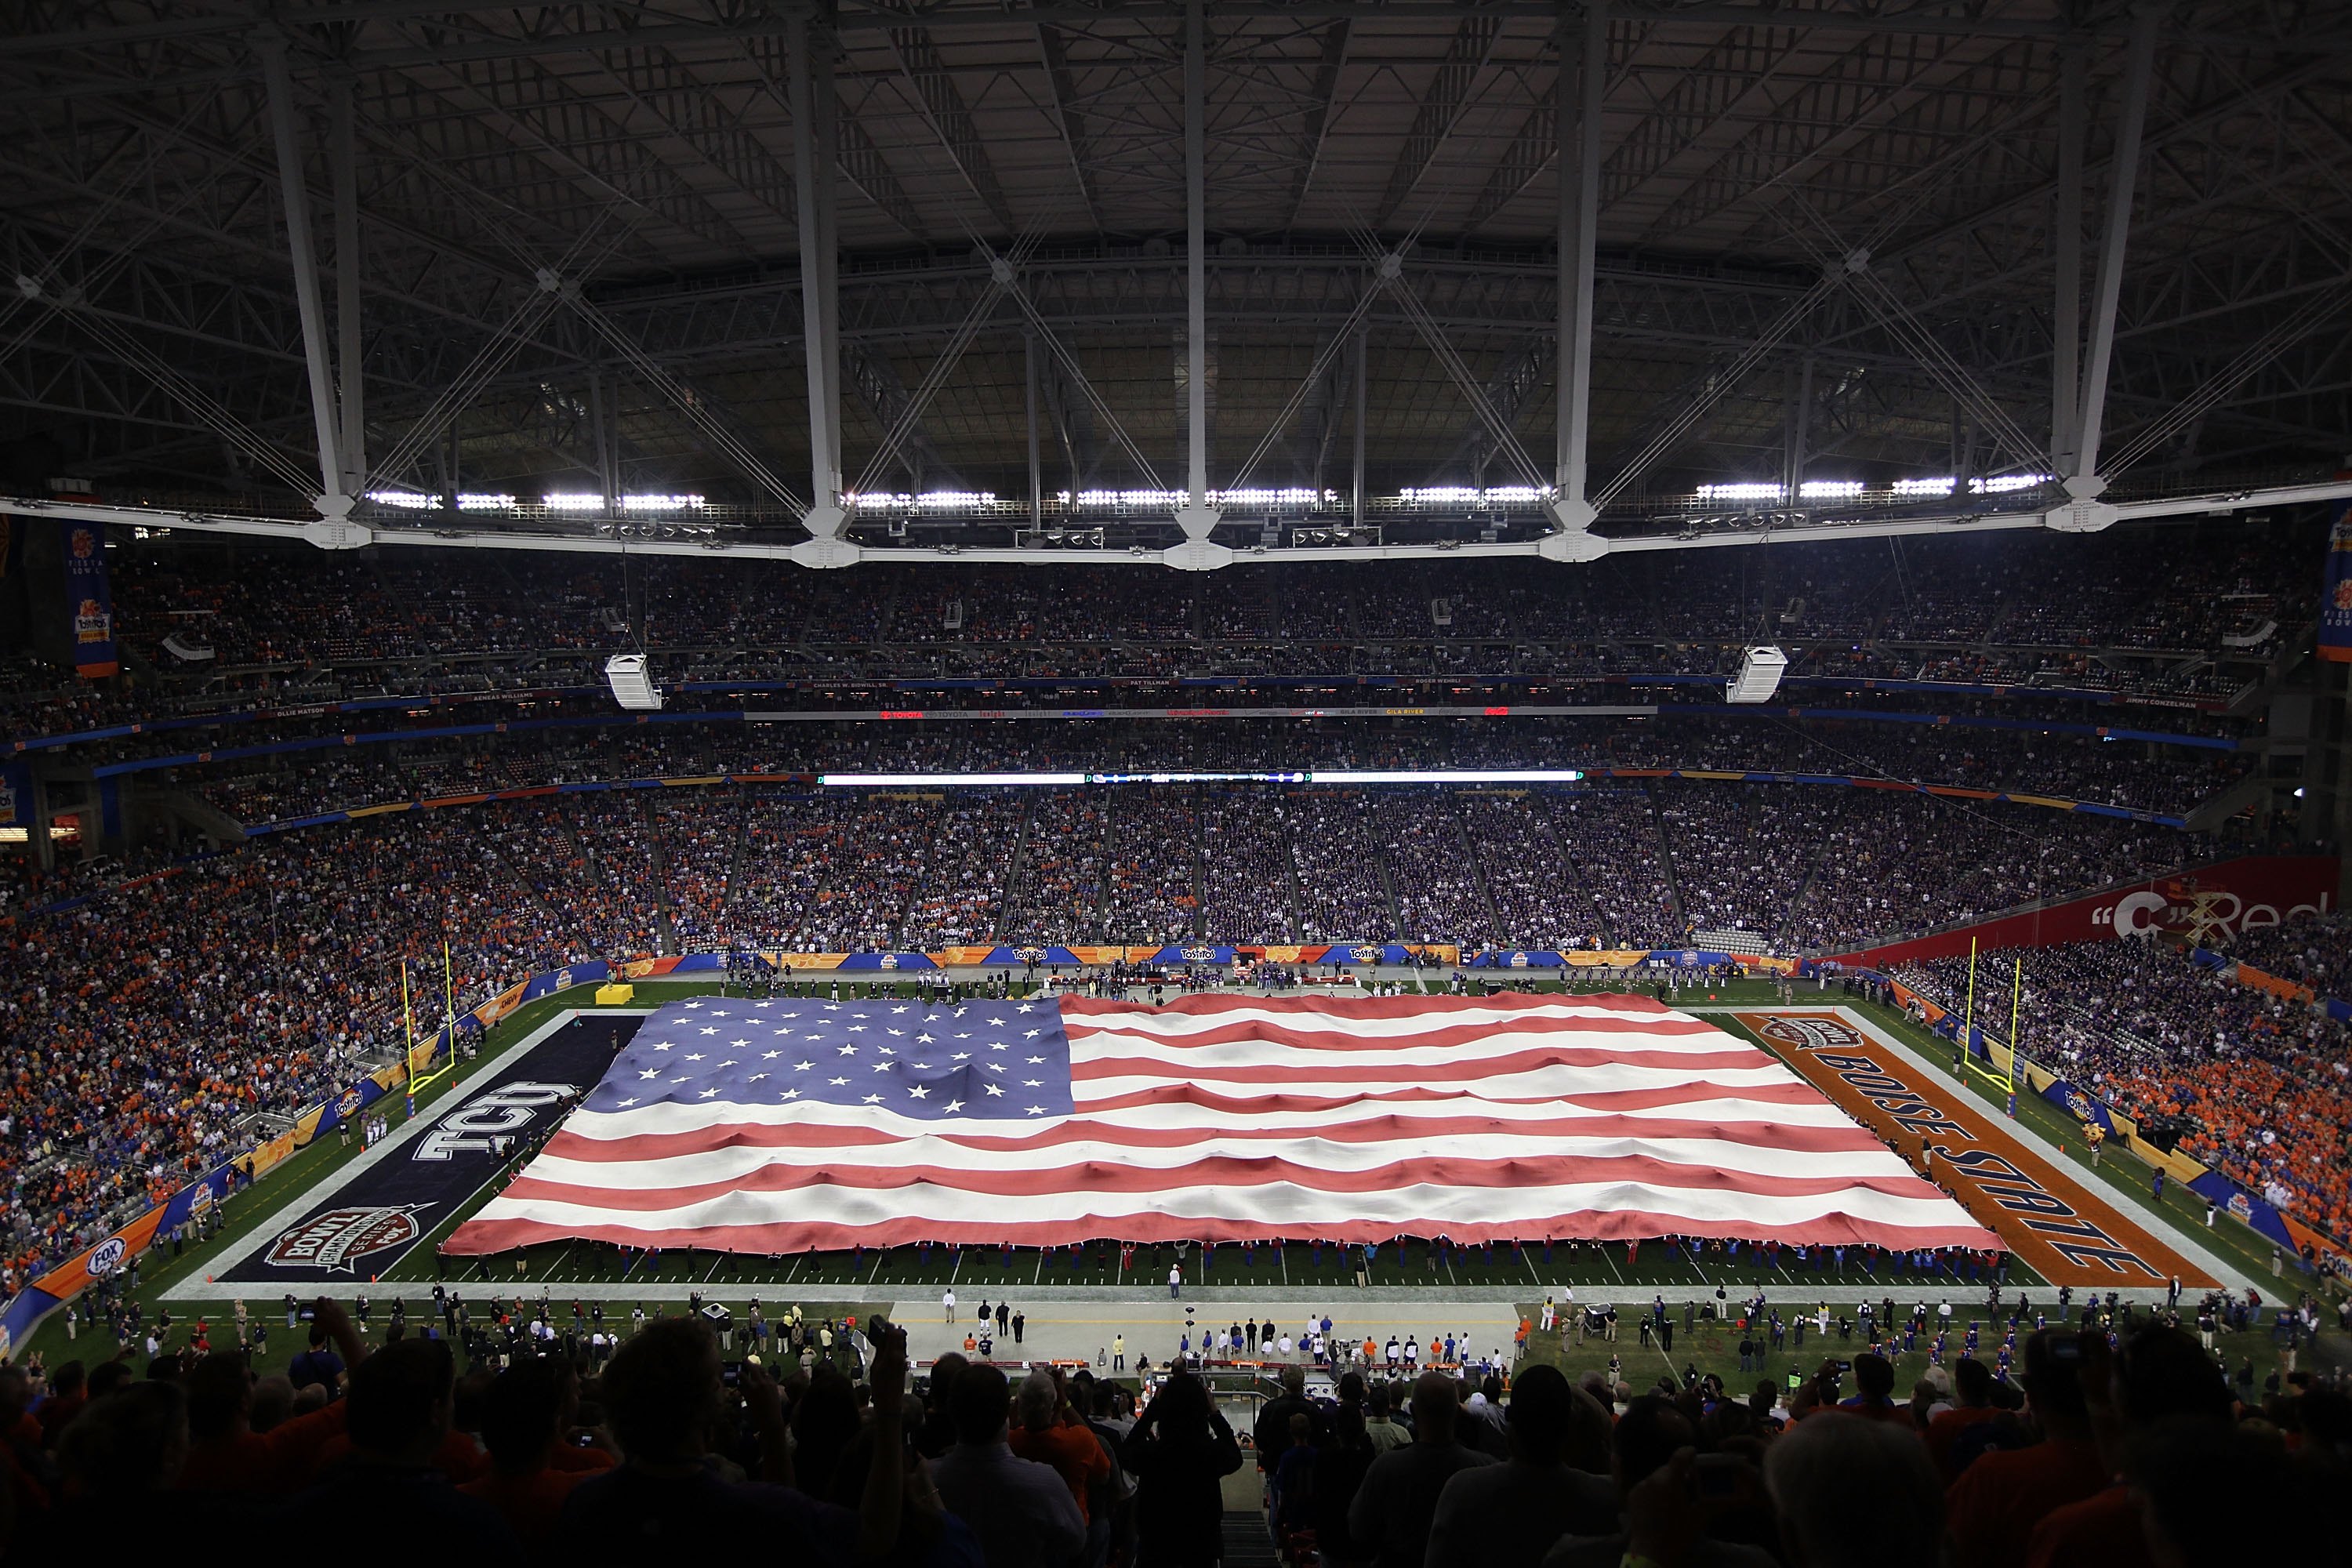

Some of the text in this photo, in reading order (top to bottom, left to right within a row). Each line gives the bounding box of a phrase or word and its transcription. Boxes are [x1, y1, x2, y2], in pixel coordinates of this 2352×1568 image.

[2150, 699, 2197, 709] CONZELMAN
[1349, 948, 1385, 959] Tostits
[501, 993, 517, 1009] CHEVY
[1805, 1022, 1851, 1044] BOWL
[412, 1081, 577, 1161] TCU
[1811, 1052, 2167, 1279] BOISE STATE
[285, 1214, 362, 1257] BOWL
[320, 1209, 392, 1262] CHAMPIONSHIP
[351, 1219, 398, 1252] SERIES
[376, 1226, 408, 1245] FOX
[95, 1242, 118, 1266] FOX
